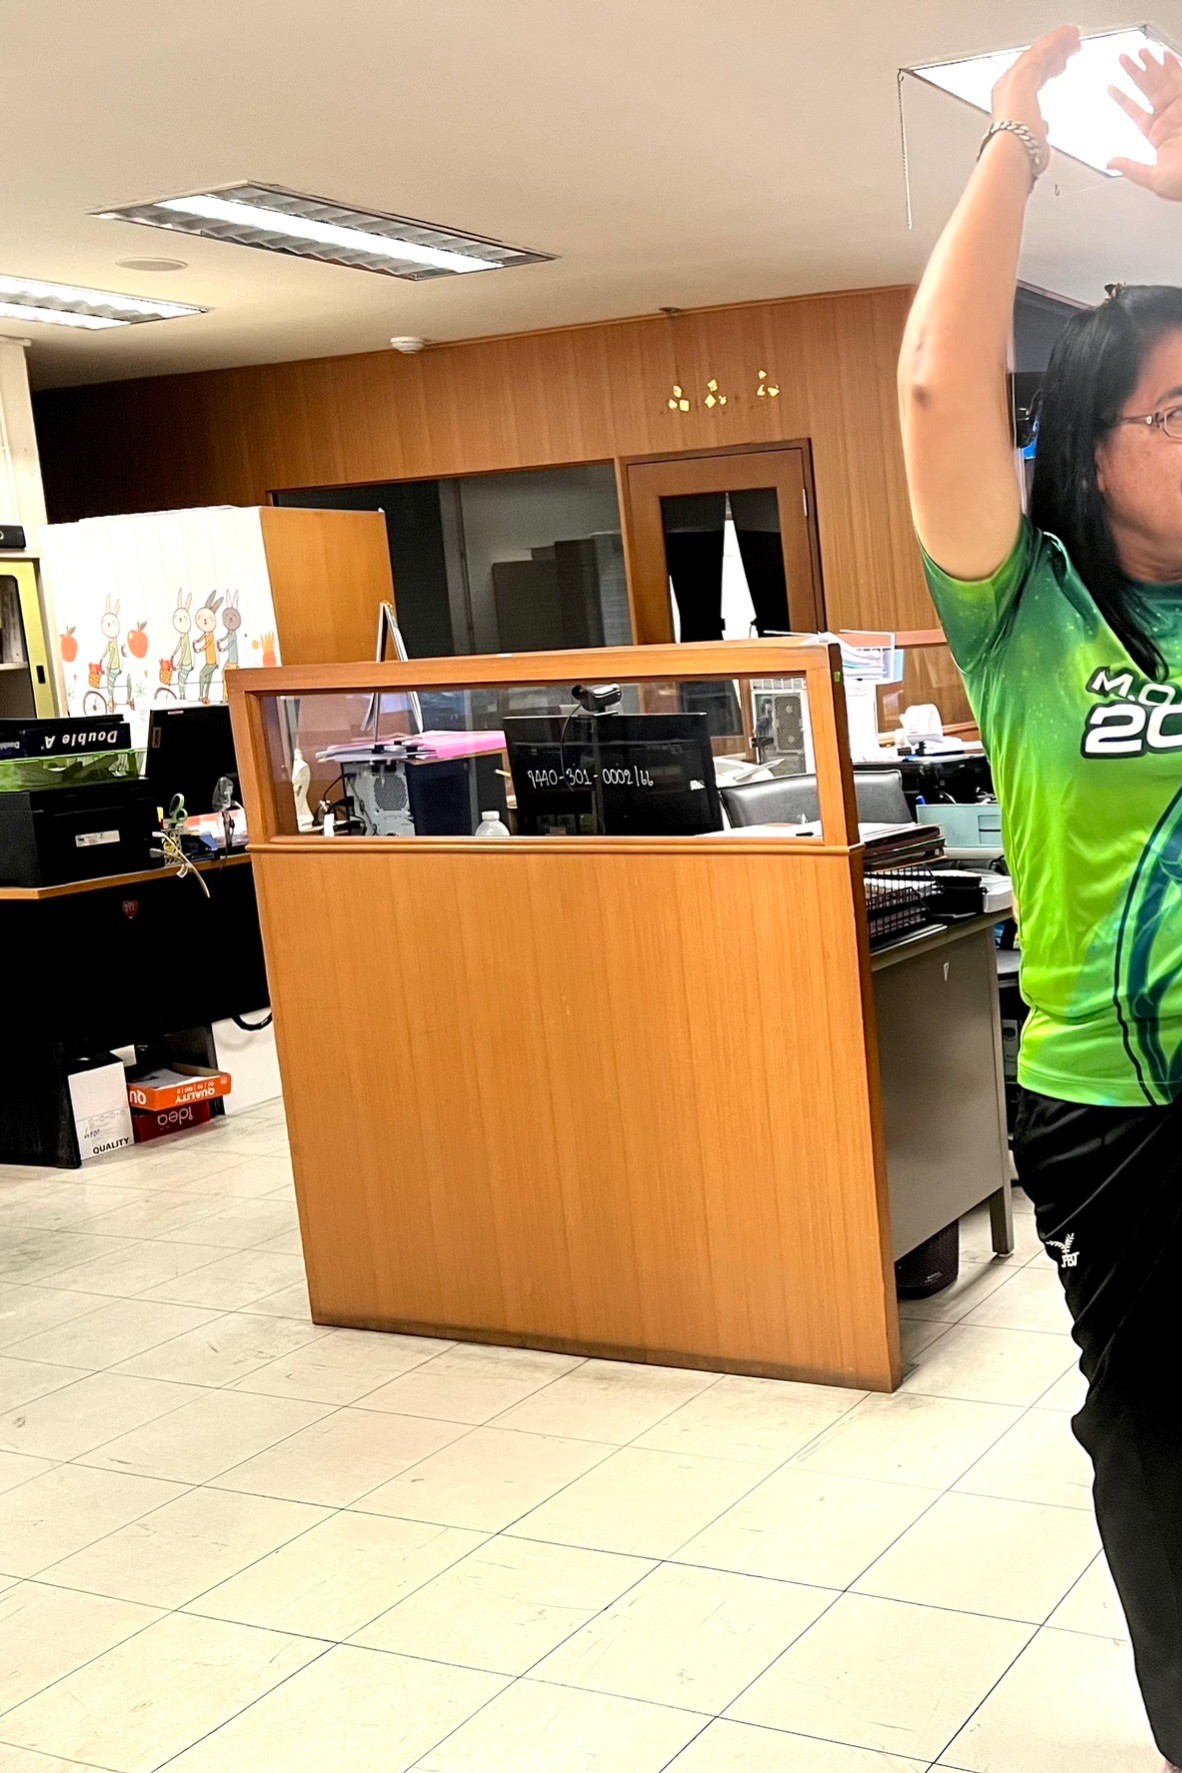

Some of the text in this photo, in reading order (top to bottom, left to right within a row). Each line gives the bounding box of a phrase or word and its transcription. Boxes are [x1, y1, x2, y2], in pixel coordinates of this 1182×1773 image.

[62, 730, 118, 747] Double
[175, 1088, 216, 1104] QUALITY
[157, 1106, 194, 1127] idea
[92, 1136, 131, 1154] QUALITY
